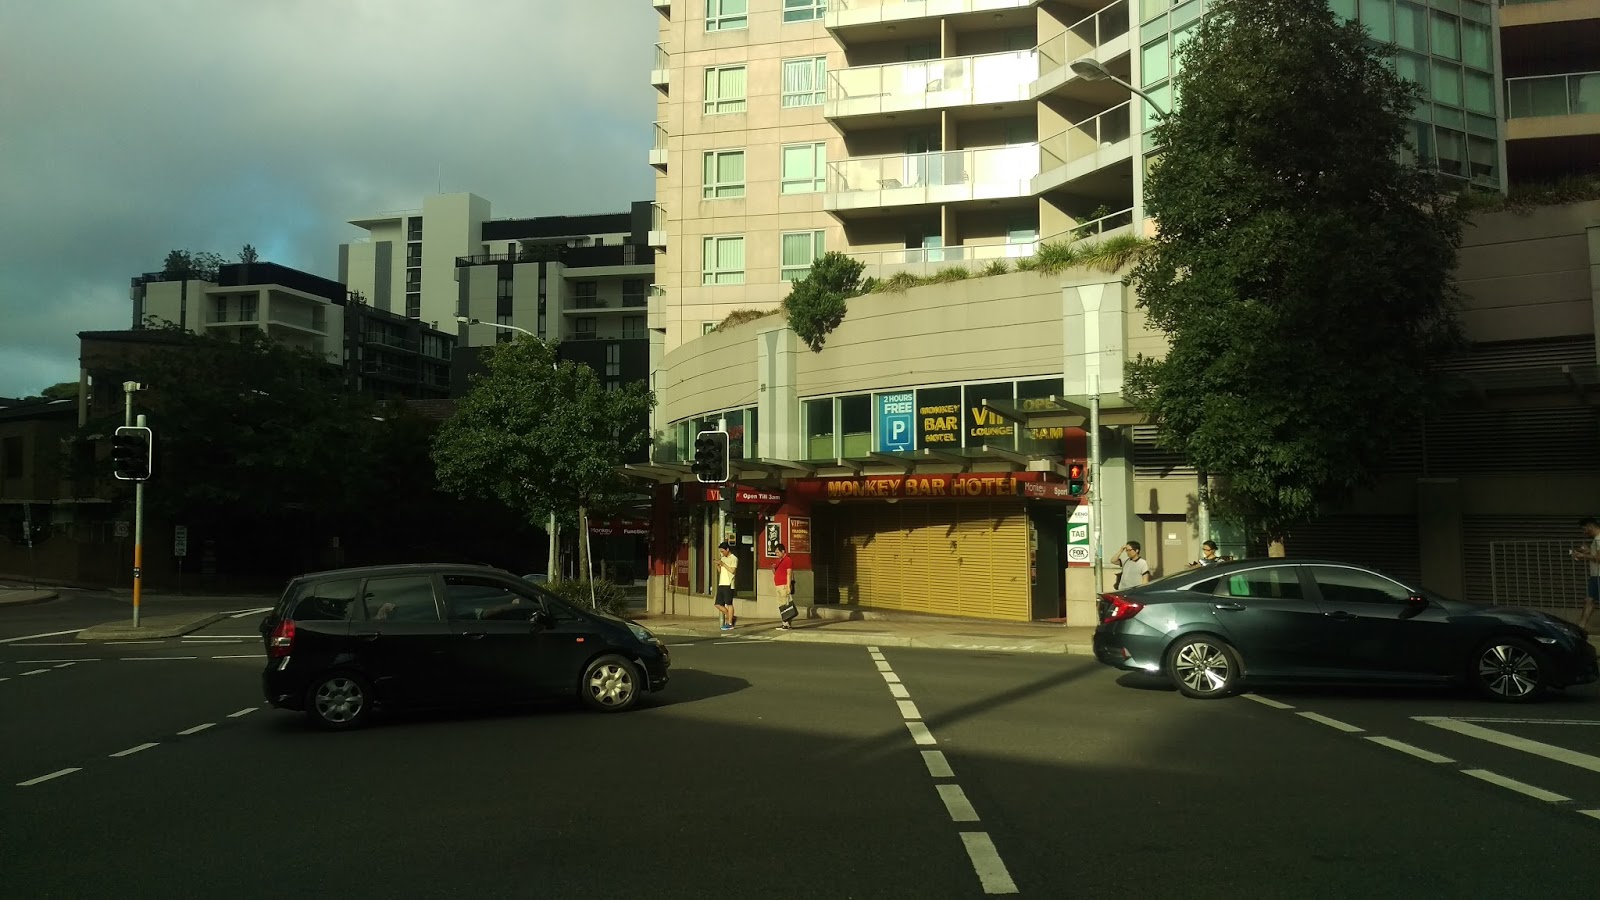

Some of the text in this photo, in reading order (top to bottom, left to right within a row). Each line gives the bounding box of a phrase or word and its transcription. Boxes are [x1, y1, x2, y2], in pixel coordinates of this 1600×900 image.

[889, 394, 913, 402] HOURS
[884, 402, 913, 414] FREE
[919, 404, 961, 415] MONKEY
[924, 416, 958, 432] BAR
[892, 420, 905, 440] P
[970, 426, 1014, 437] LOUNGE
[924, 433, 957, 443] HOTEL
[827, 478, 900, 498] MONKEY
[905, 478, 946, 497] BAR
[1024, 482, 1047, 493] Monkey
[742, 492, 758, 501] Open
[768, 493, 781, 501] 3am
[1071, 530, 1086, 538] TAB
